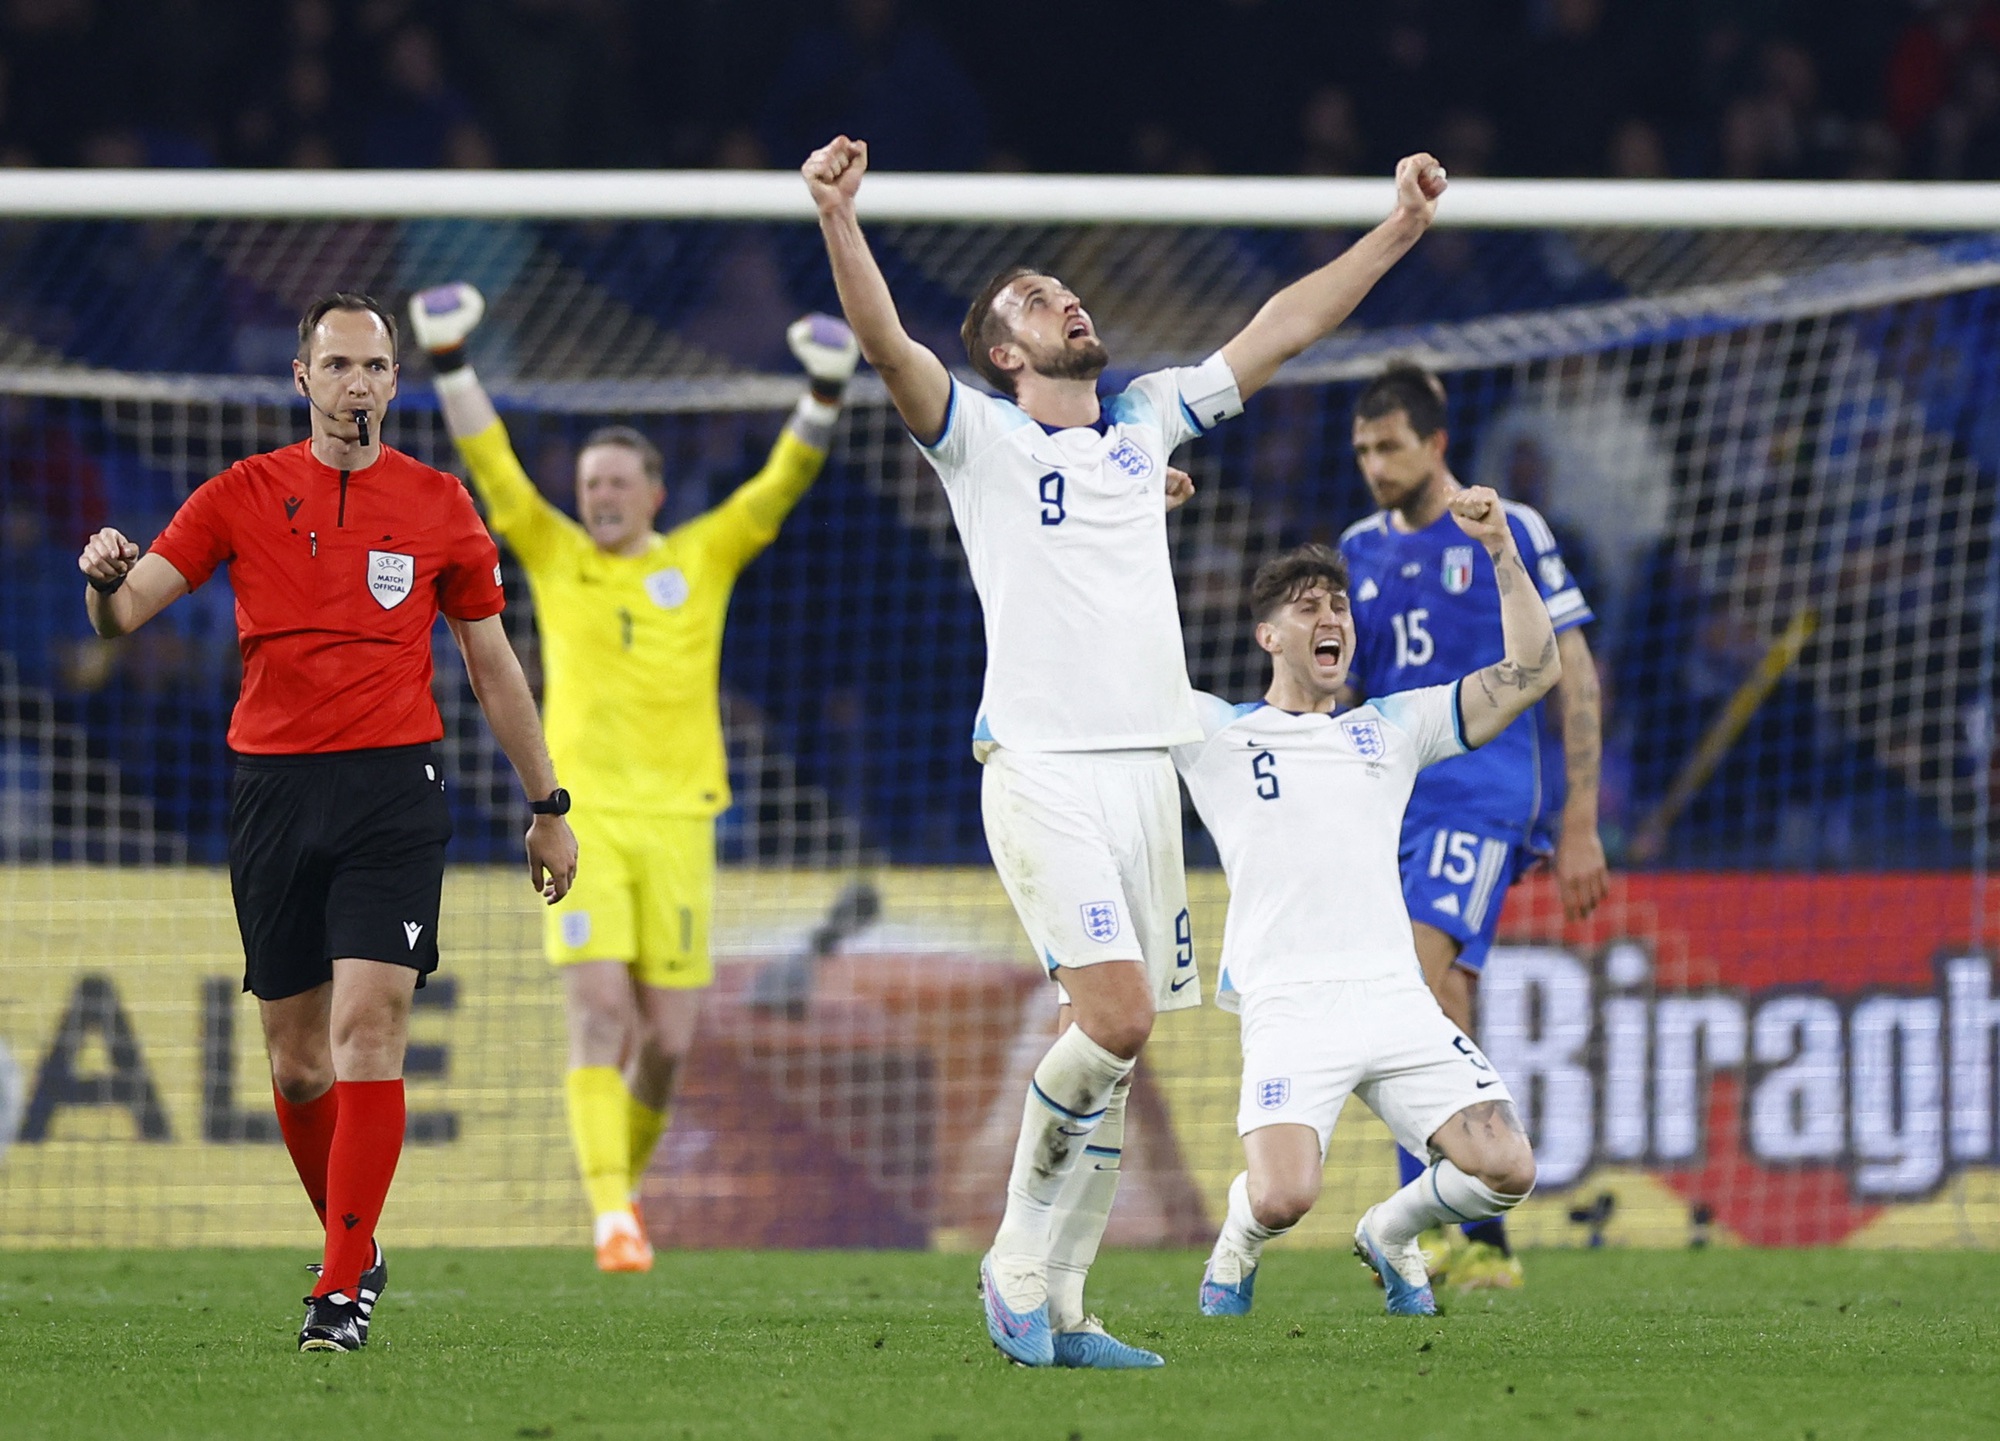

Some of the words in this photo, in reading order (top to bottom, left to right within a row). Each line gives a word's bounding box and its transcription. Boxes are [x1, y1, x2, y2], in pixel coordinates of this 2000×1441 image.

[1039, 471, 1066, 525] 9
[373, 583, 406, 593] OFFICIAL
[377, 558, 405, 571] UEFA
[377, 574, 404, 584] MATCH
[618, 607, 633, 648] 1
[1390, 608, 1434, 669] 15
[1252, 750, 1280, 800] 5
[1428, 829, 1479, 885] 15
[679, 906, 692, 953] 1
[1175, 907, 1192, 968] 9
